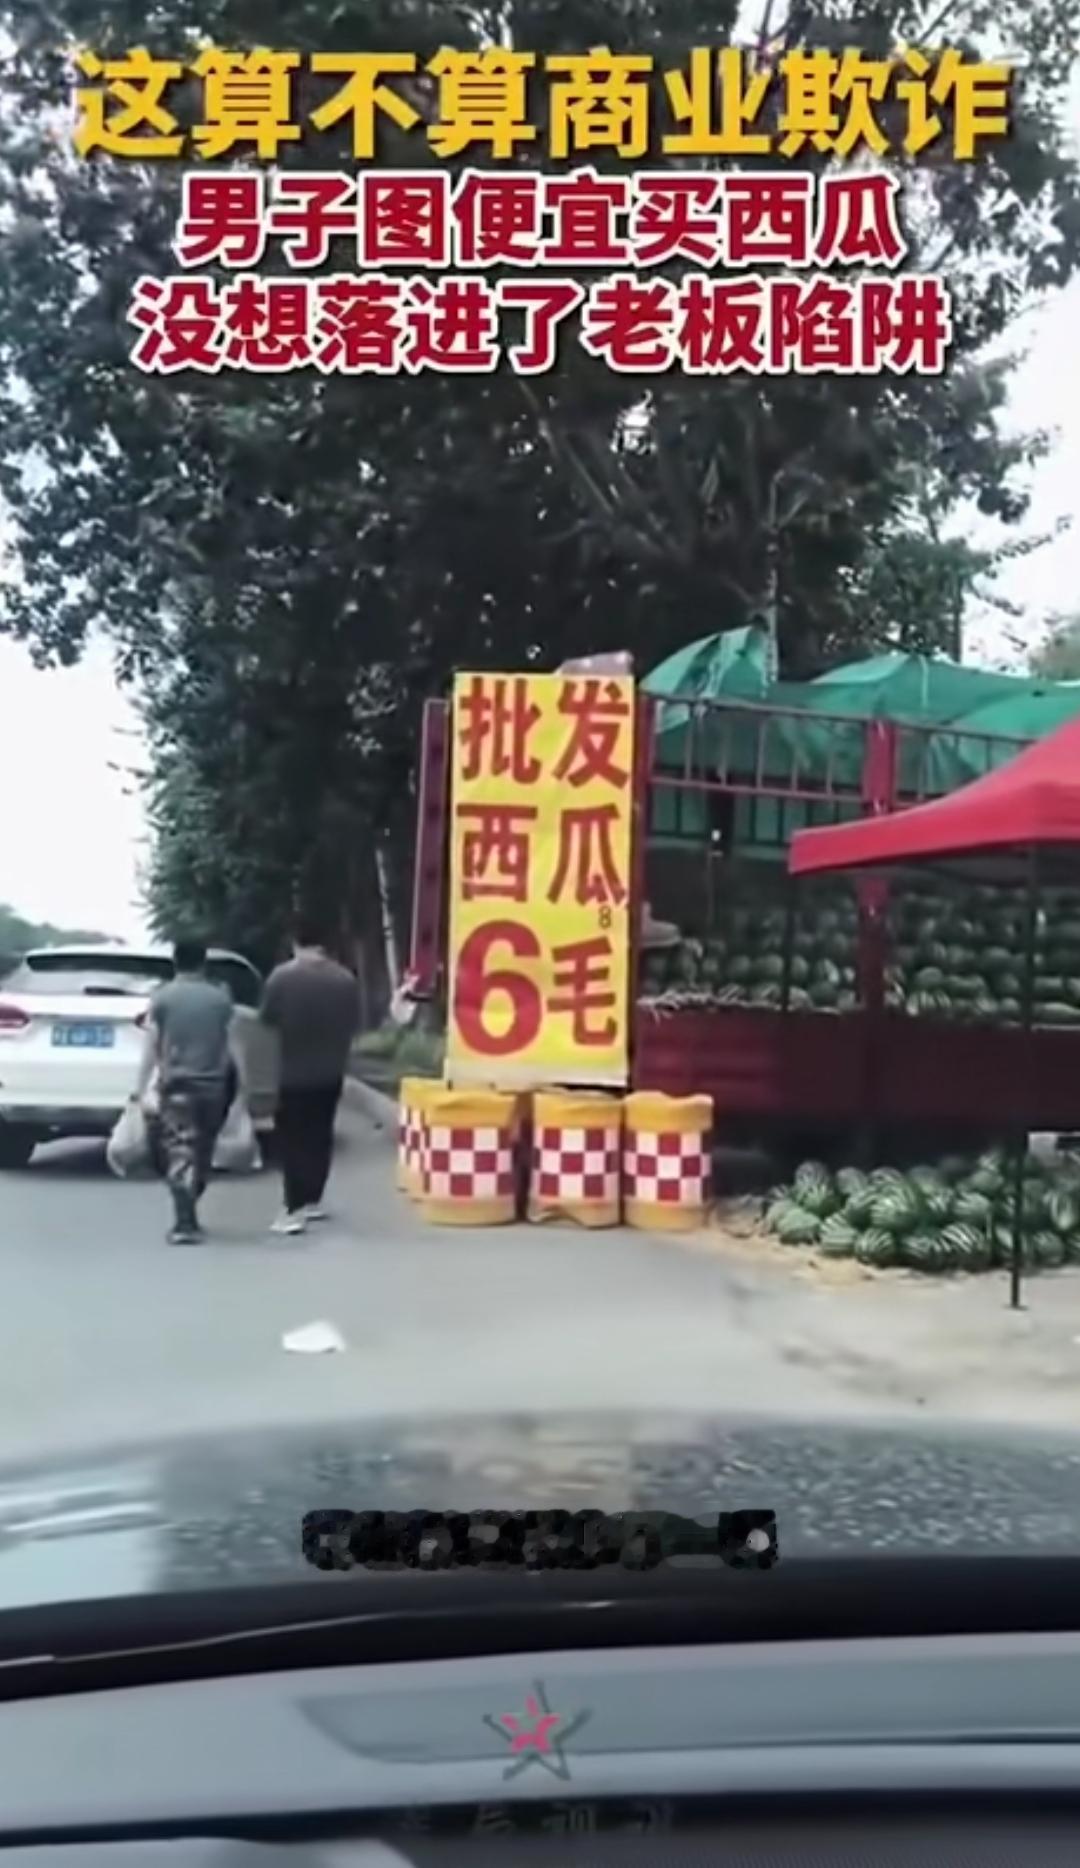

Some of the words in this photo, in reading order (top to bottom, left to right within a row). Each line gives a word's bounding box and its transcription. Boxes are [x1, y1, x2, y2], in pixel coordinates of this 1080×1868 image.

[458, 677, 630, 788] 批发
[456, 803, 628, 906] 西瓜
[455, 919, 618, 1056] 6毛
